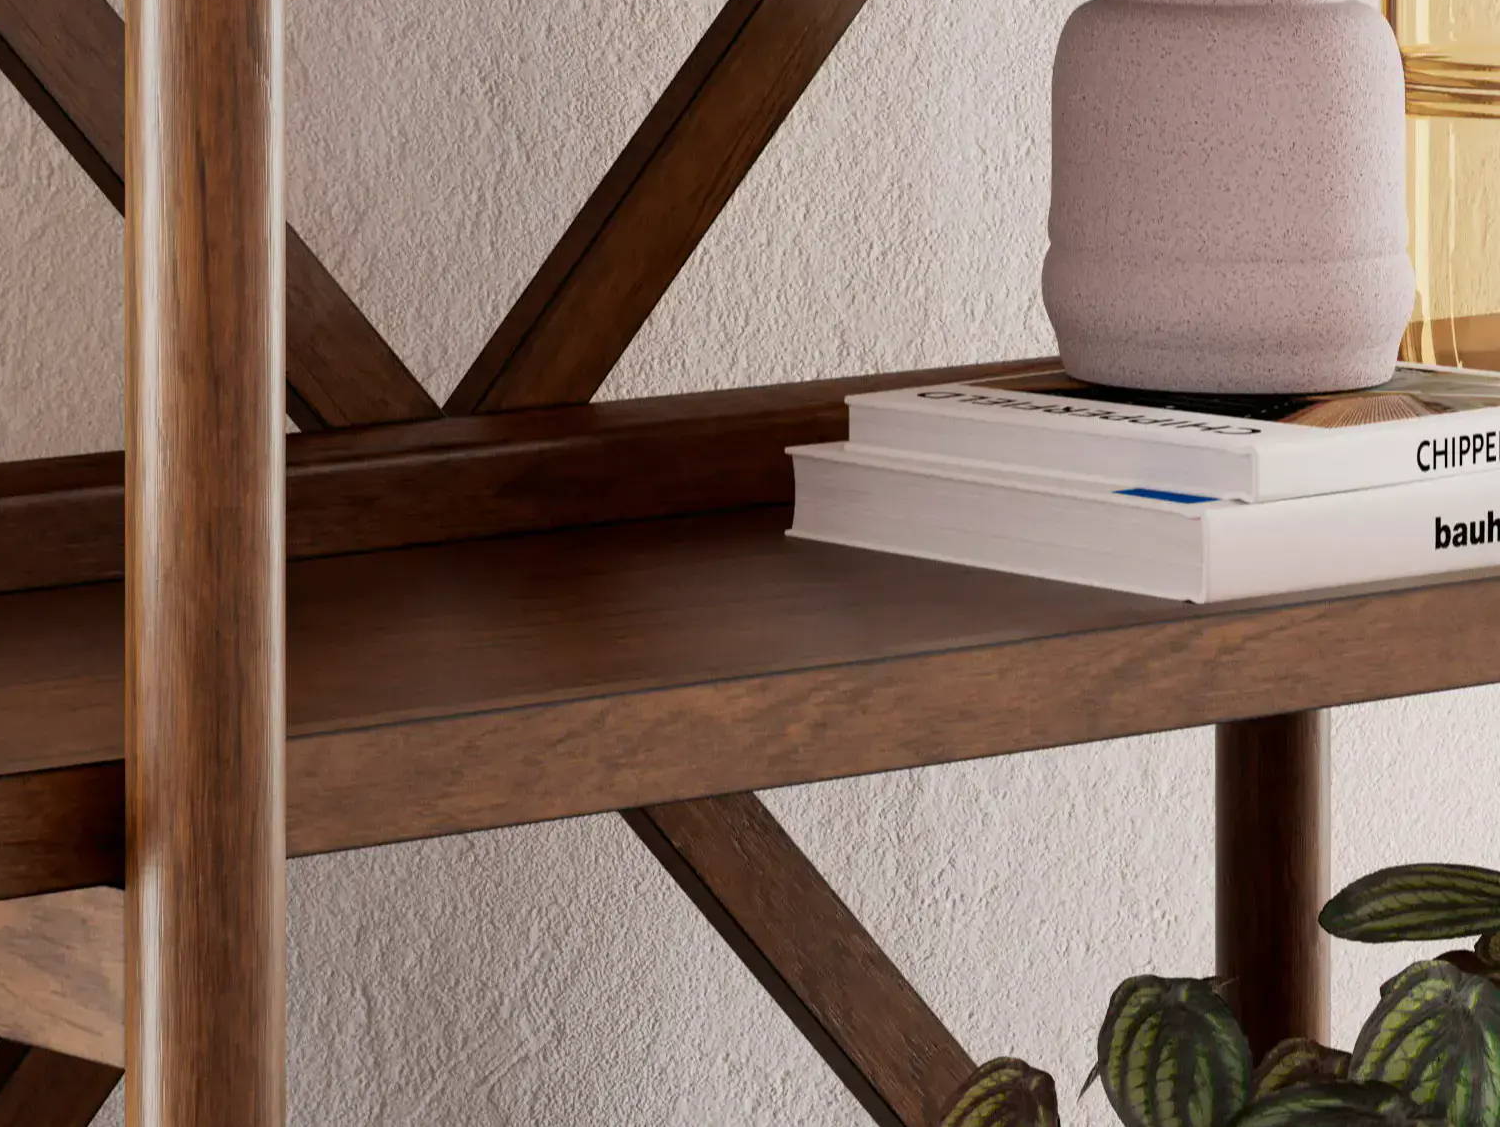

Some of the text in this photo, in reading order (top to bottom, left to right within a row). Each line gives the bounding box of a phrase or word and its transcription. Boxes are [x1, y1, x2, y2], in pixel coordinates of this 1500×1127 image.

[917, 391, 1262, 435] CHIPPERFIELD
[1417, 431, 1500, 472] CHIPPE
[1435, 510, 1500, 550] bauh
